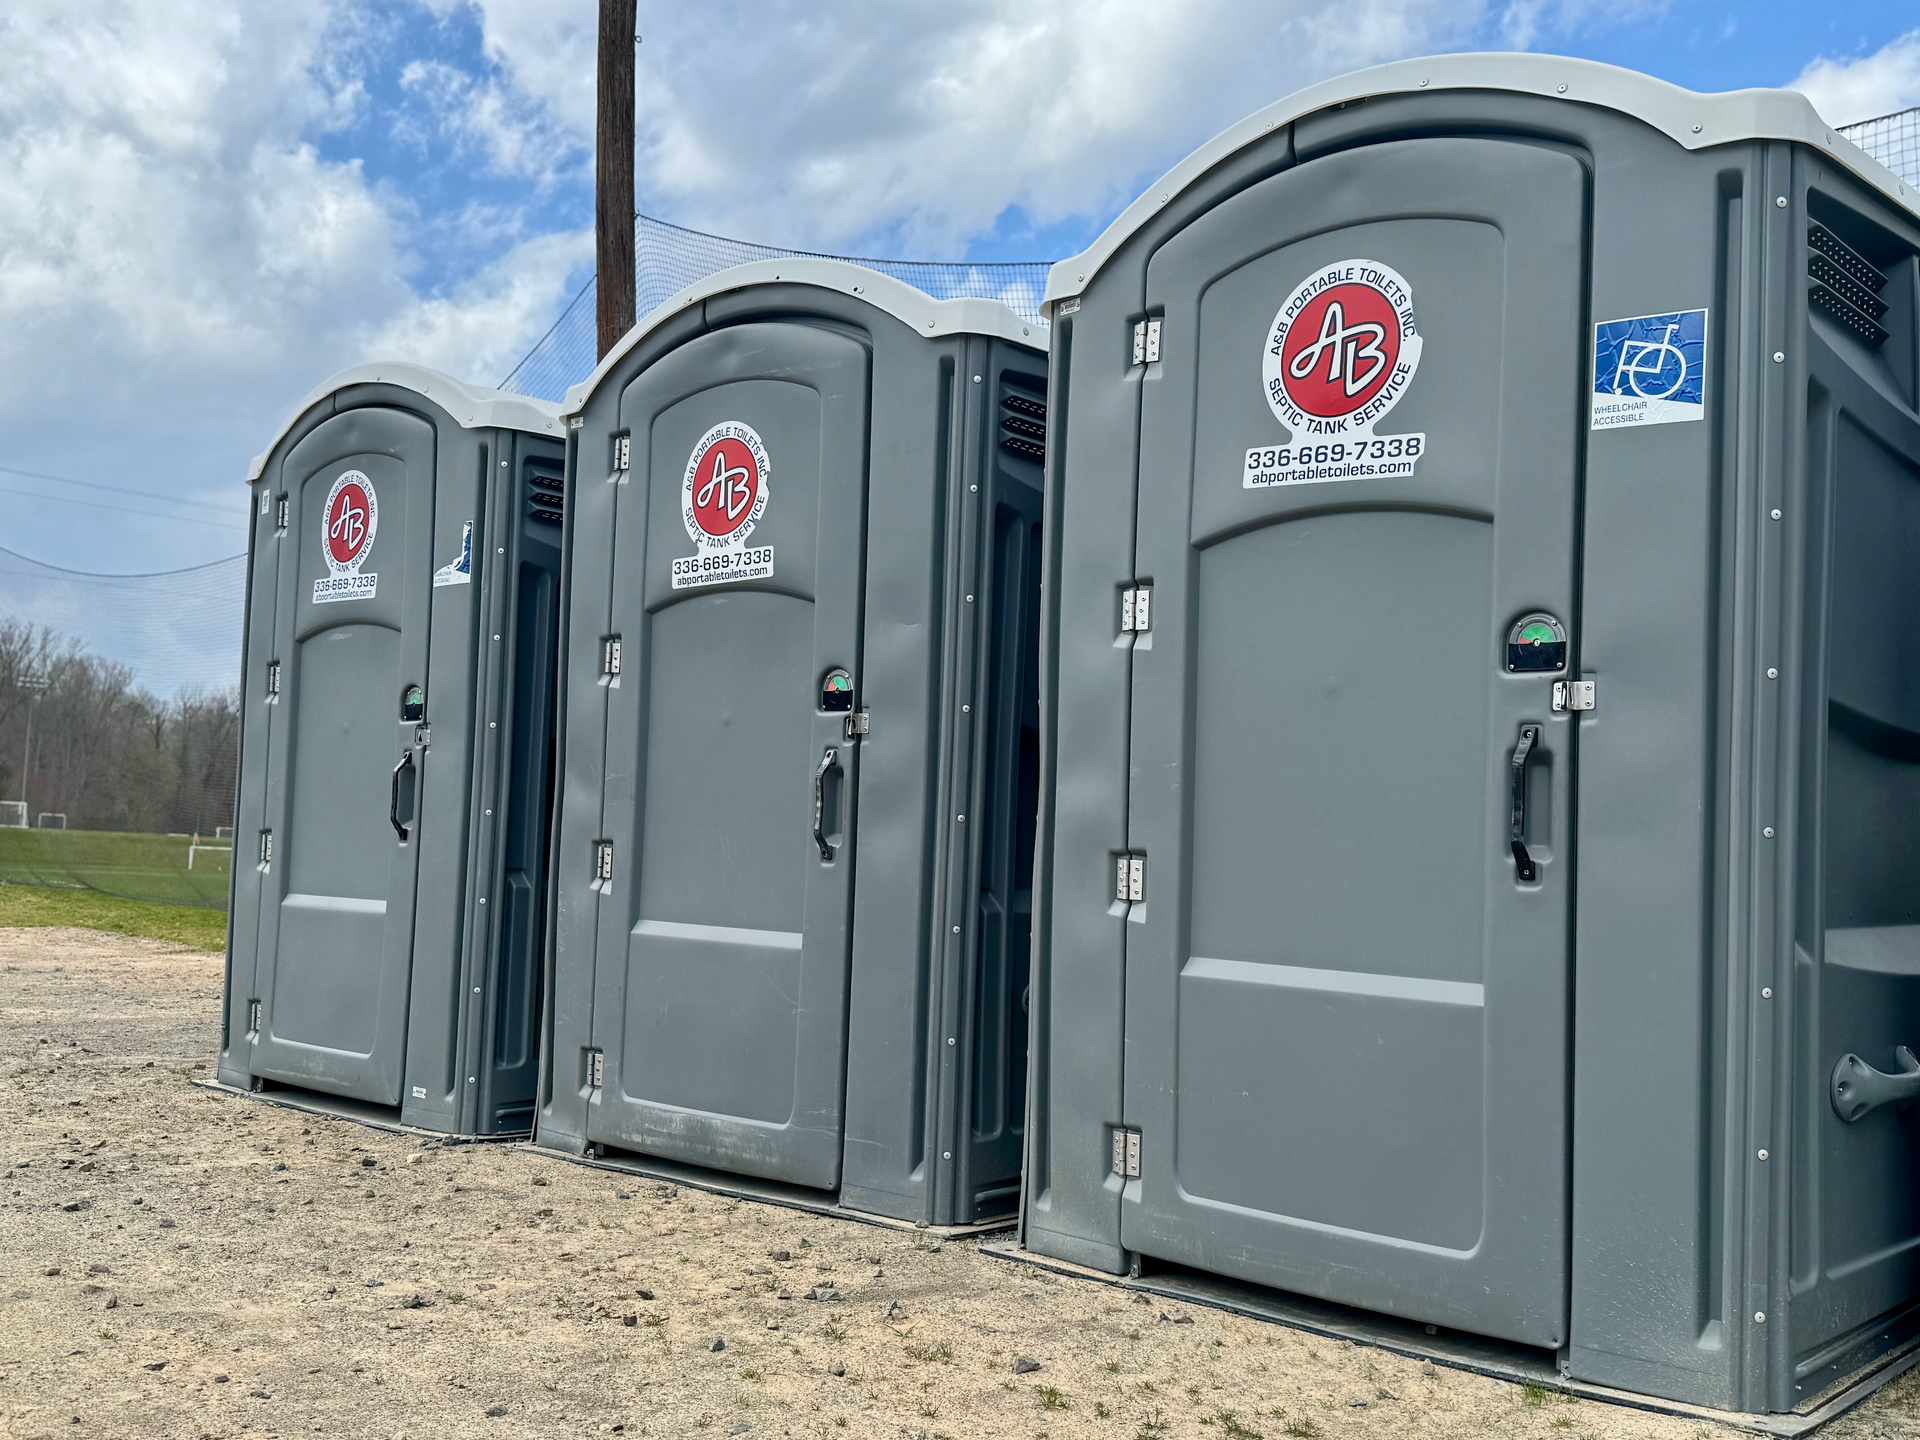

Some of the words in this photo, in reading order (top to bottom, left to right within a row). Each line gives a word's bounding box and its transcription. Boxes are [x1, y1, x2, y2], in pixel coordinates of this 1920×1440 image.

[1271, 321, 1288, 355] A&B
[1286, 268, 1354, 318] PORTABLE
[1360, 268, 1406, 307] TOILETS
[1400, 308, 1415, 341] INC.
[1289, 300, 1387, 398] AB
[1270, 378, 1303, 426] SEPTIC
[1306, 418, 1348, 434] TANK
[1353, 362, 1411, 426] SERVICE
[1594, 402, 1647, 414] WHEELCHAIR
[1594, 413, 1644, 426] ACCESSIBLE
[686, 467, 695, 491] A&B
[693, 427, 730, 464] PORTABLE
[733, 427, 760, 456] TOILETS
[1248, 438, 1420, 469] 336-669-7338
[330, 475, 354, 502] PORTABLE
[356, 475, 372, 499] TOILETS
[696, 451, 751, 521] AB
[1252, 462, 1411, 485] abportabletoilets.com
[331, 494, 365, 551] AB
[685, 507, 705, 542] SEPTIC
[707, 536, 730, 548] TANK
[733, 495, 765, 542] SERVICE
[335, 563, 350, 572] TANK
[352, 532, 373, 568] SERVICE
[674, 549, 772, 574] 336-669-7338
[315, 576, 376, 592] 336-669-7338
[677, 566, 767, 587] abportabletoilets.com
[316, 589, 372, 602] abportabletoilets.com
